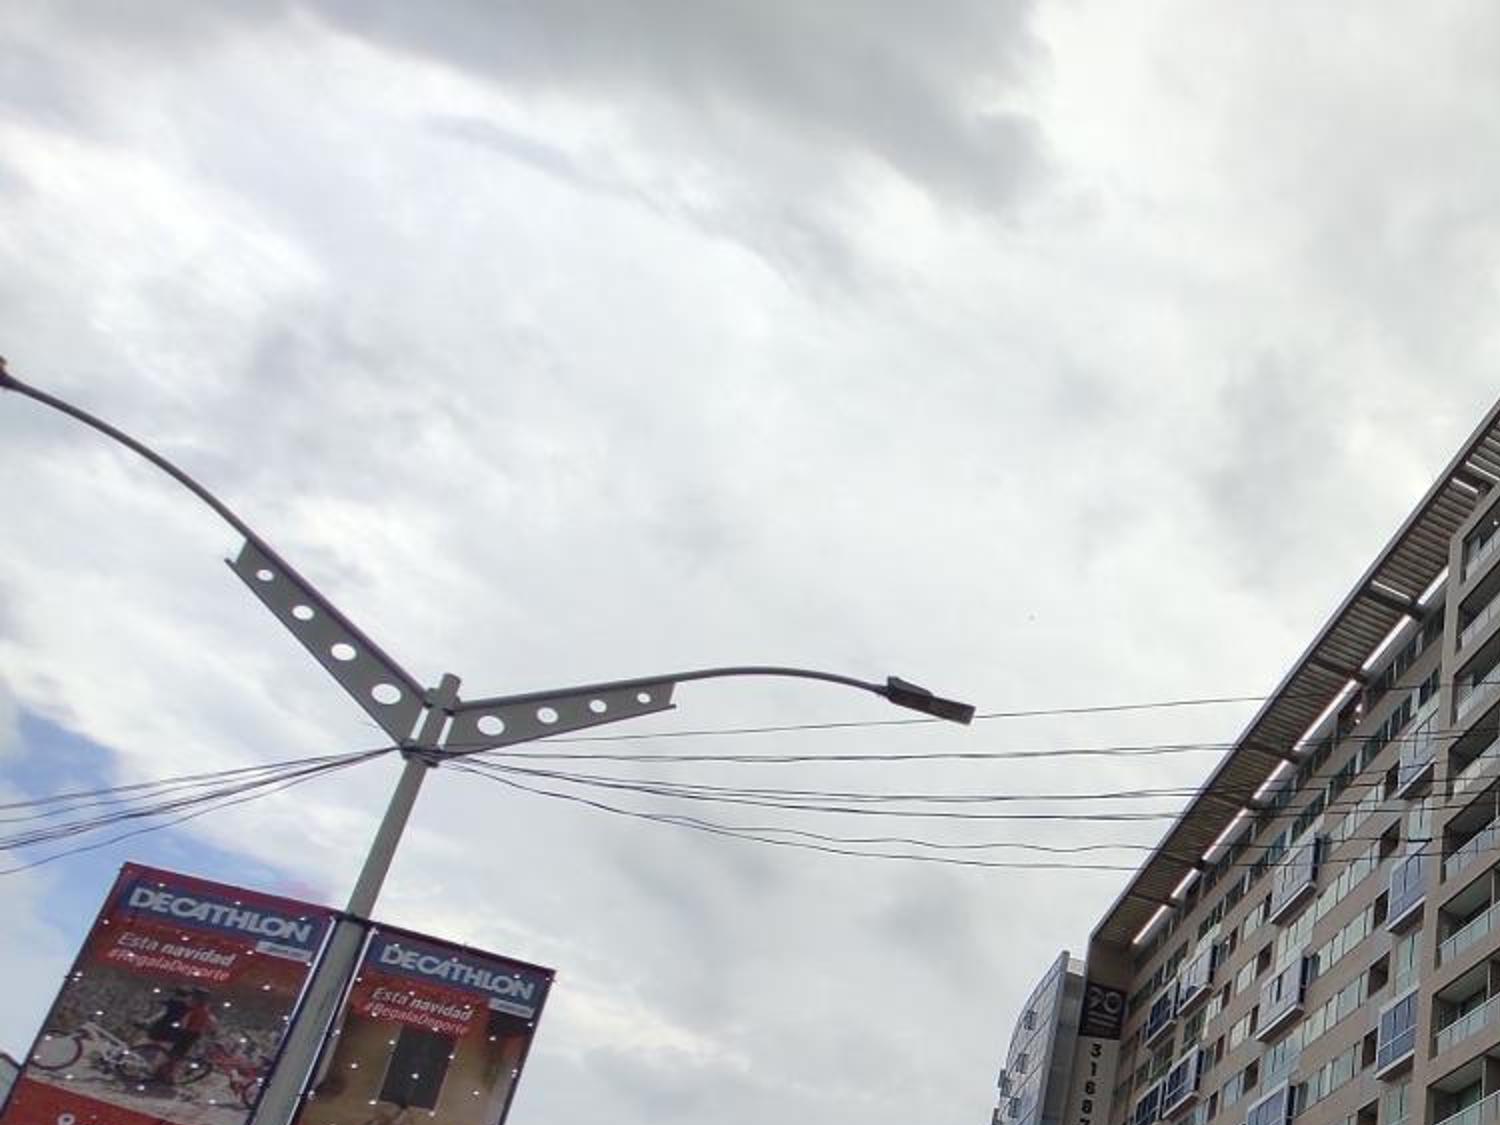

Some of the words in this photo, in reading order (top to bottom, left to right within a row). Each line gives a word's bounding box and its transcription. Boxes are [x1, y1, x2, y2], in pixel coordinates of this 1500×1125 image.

[128, 887, 314, 942] DECATHLON
[107, 947, 232, 981] #RegalaDeporte
[118, 932, 159, 951] Esta
[161, 944, 236, 967] navidad
[380, 945, 535, 1000] DECATHLON
[363, 1003, 468, 1035] #RegalaDeporte
[372, 987, 409, 1005] Esta
[409, 997, 474, 1021] navidad
